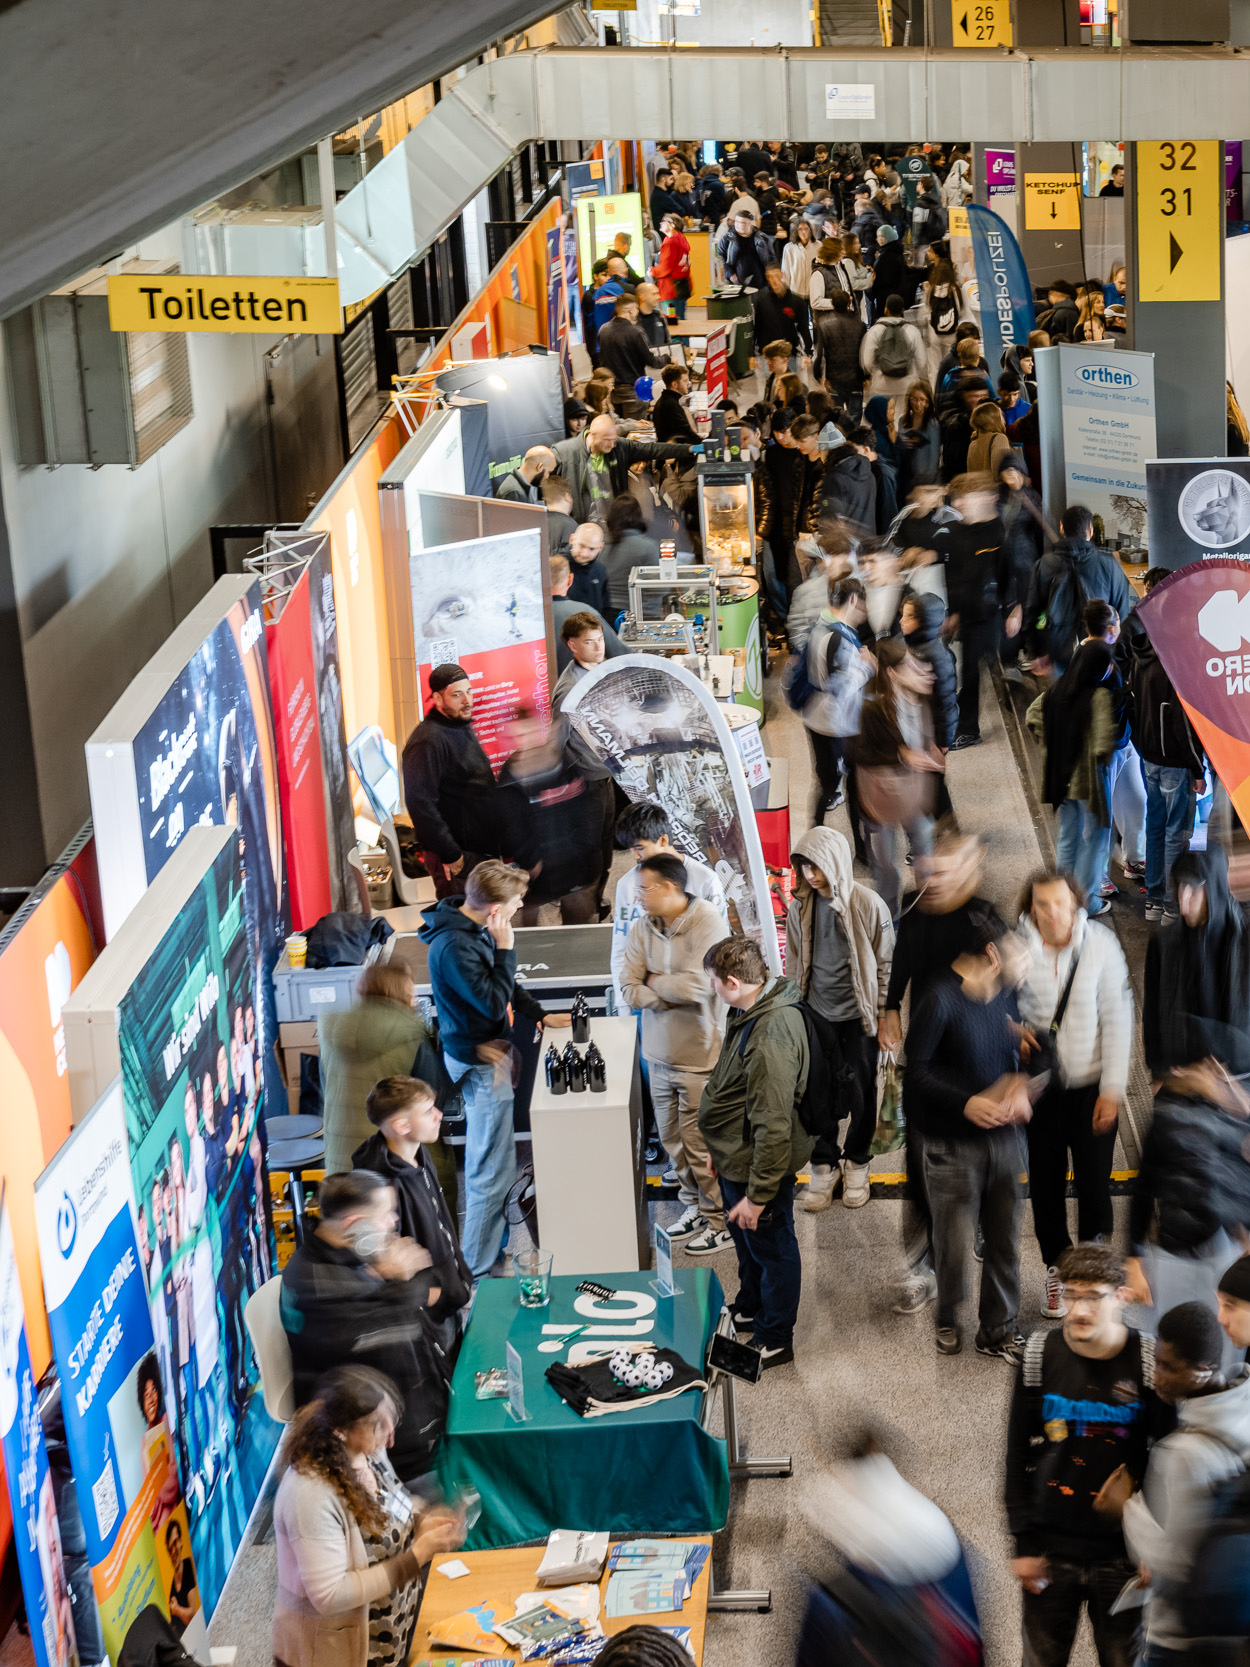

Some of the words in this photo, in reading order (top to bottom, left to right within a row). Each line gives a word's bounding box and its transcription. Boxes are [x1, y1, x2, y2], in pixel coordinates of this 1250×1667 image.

[975, 6, 994, 21] 26
[976, 25, 995, 40] 27
[1159, 142, 1197, 171] 32
[1160, 188, 1192, 216] 31
[139, 287, 307, 322] Toiletten
[1082, 367, 1132, 386] orthen
[1089, 417, 1109, 427] Orthen
[1111, 420, 1129, 429] GmbH
[1072, 472, 1108, 484] Gemeinsam
[1108, 477, 1115, 486] in
[1116, 478, 1125, 488] die
[1126, 481, 1147, 491] Zukun
[67, 1299, 105, 1380] STARTE
[102, 1246, 137, 1314] DEINE
[75, 1313, 124, 1417] KARRIERE
